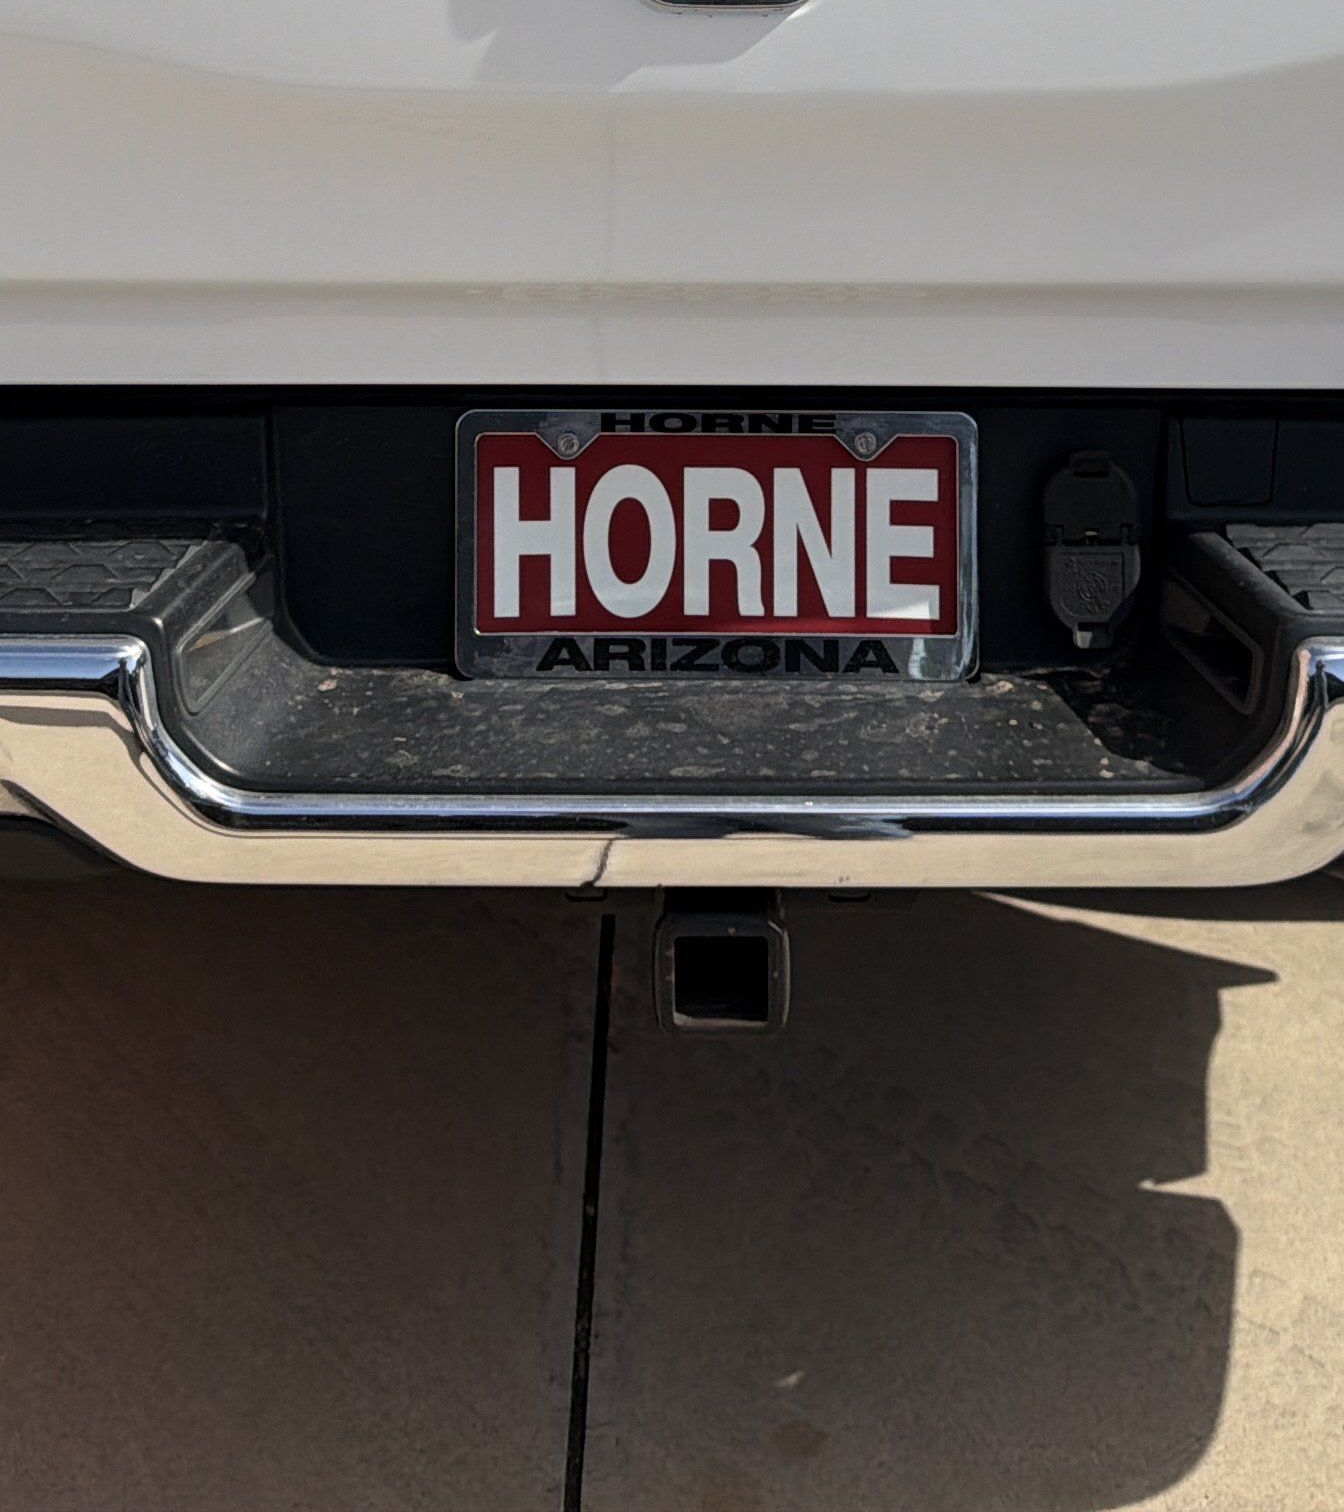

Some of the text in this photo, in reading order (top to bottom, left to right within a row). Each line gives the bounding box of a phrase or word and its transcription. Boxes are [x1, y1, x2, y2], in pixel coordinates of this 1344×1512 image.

[599, 411, 838, 435] HORNE
[492, 463, 941, 622] HORNE
[535, 637, 901, 675] ARIZONA
